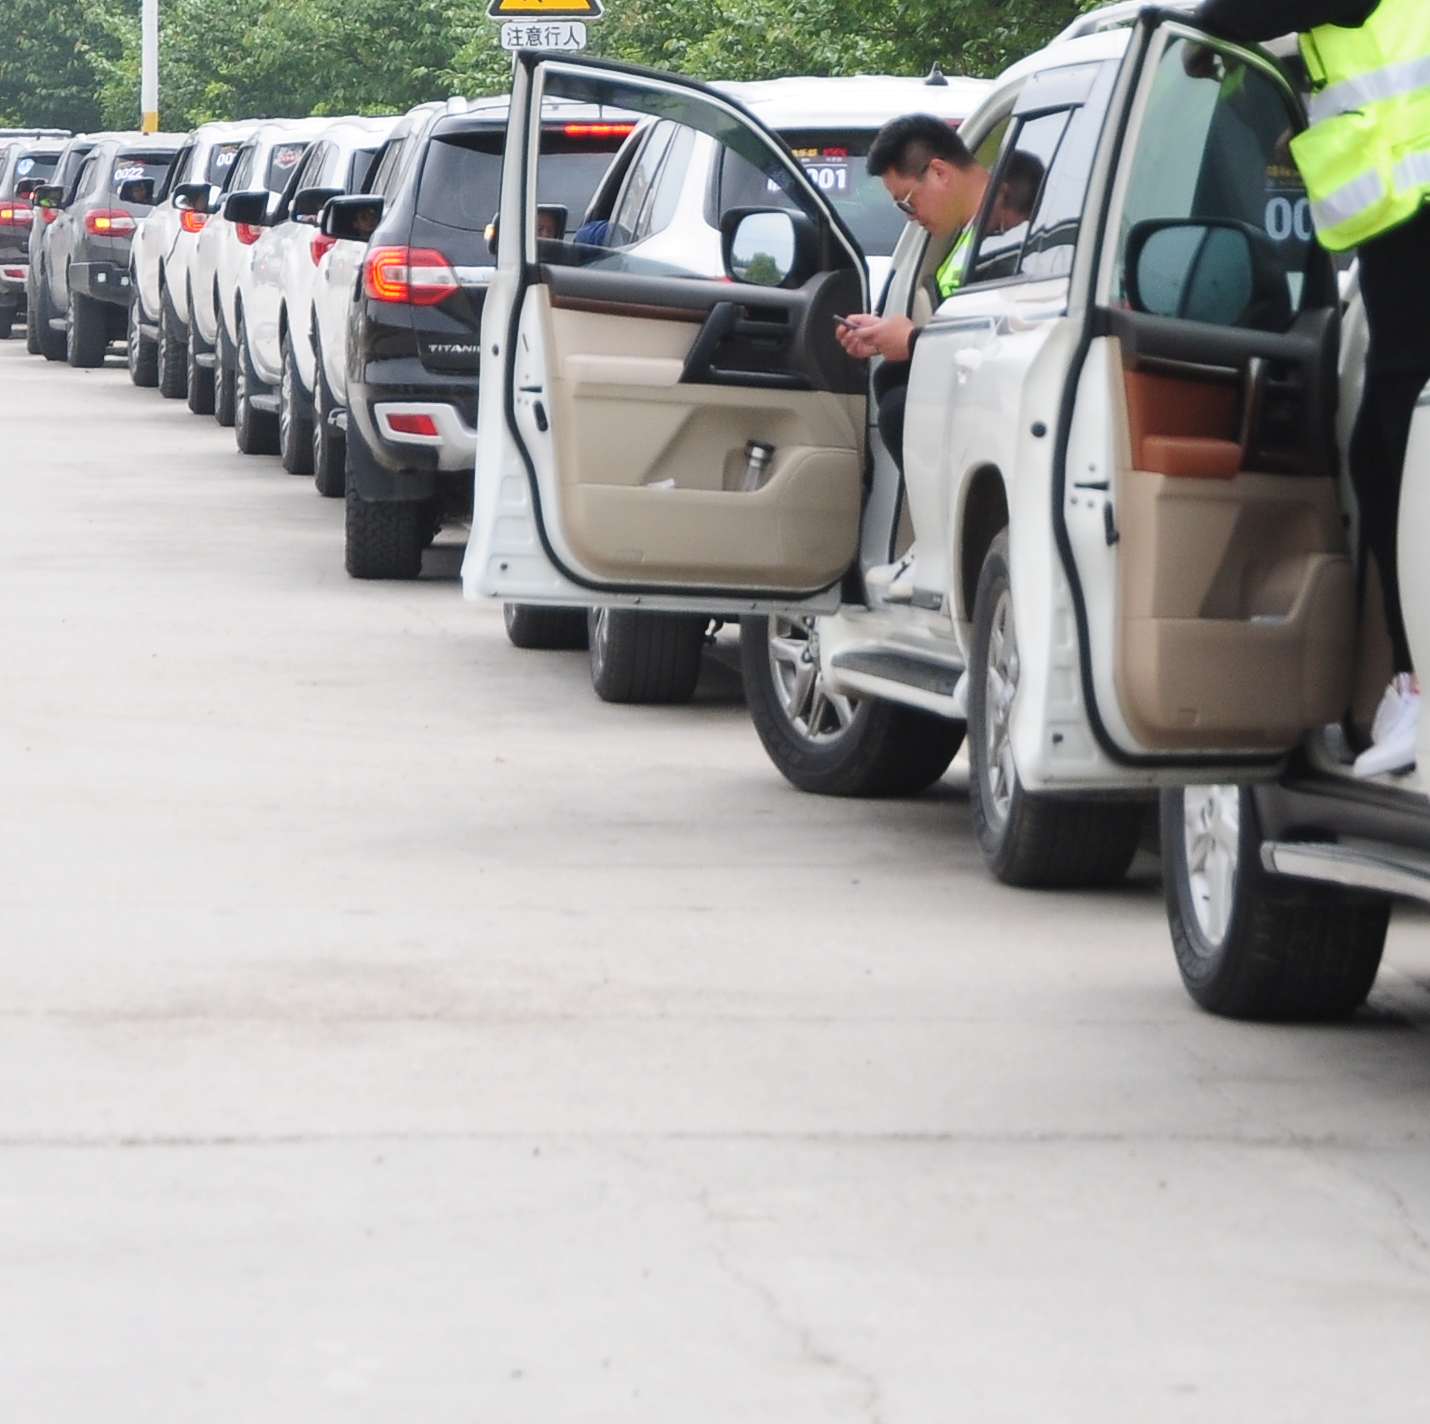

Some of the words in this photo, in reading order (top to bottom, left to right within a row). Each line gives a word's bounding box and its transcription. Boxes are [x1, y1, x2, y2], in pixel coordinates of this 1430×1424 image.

[506, 25, 581, 50] 注意行人
[216, 151, 237, 167] 00
[114, 166, 145, 181] 0022
